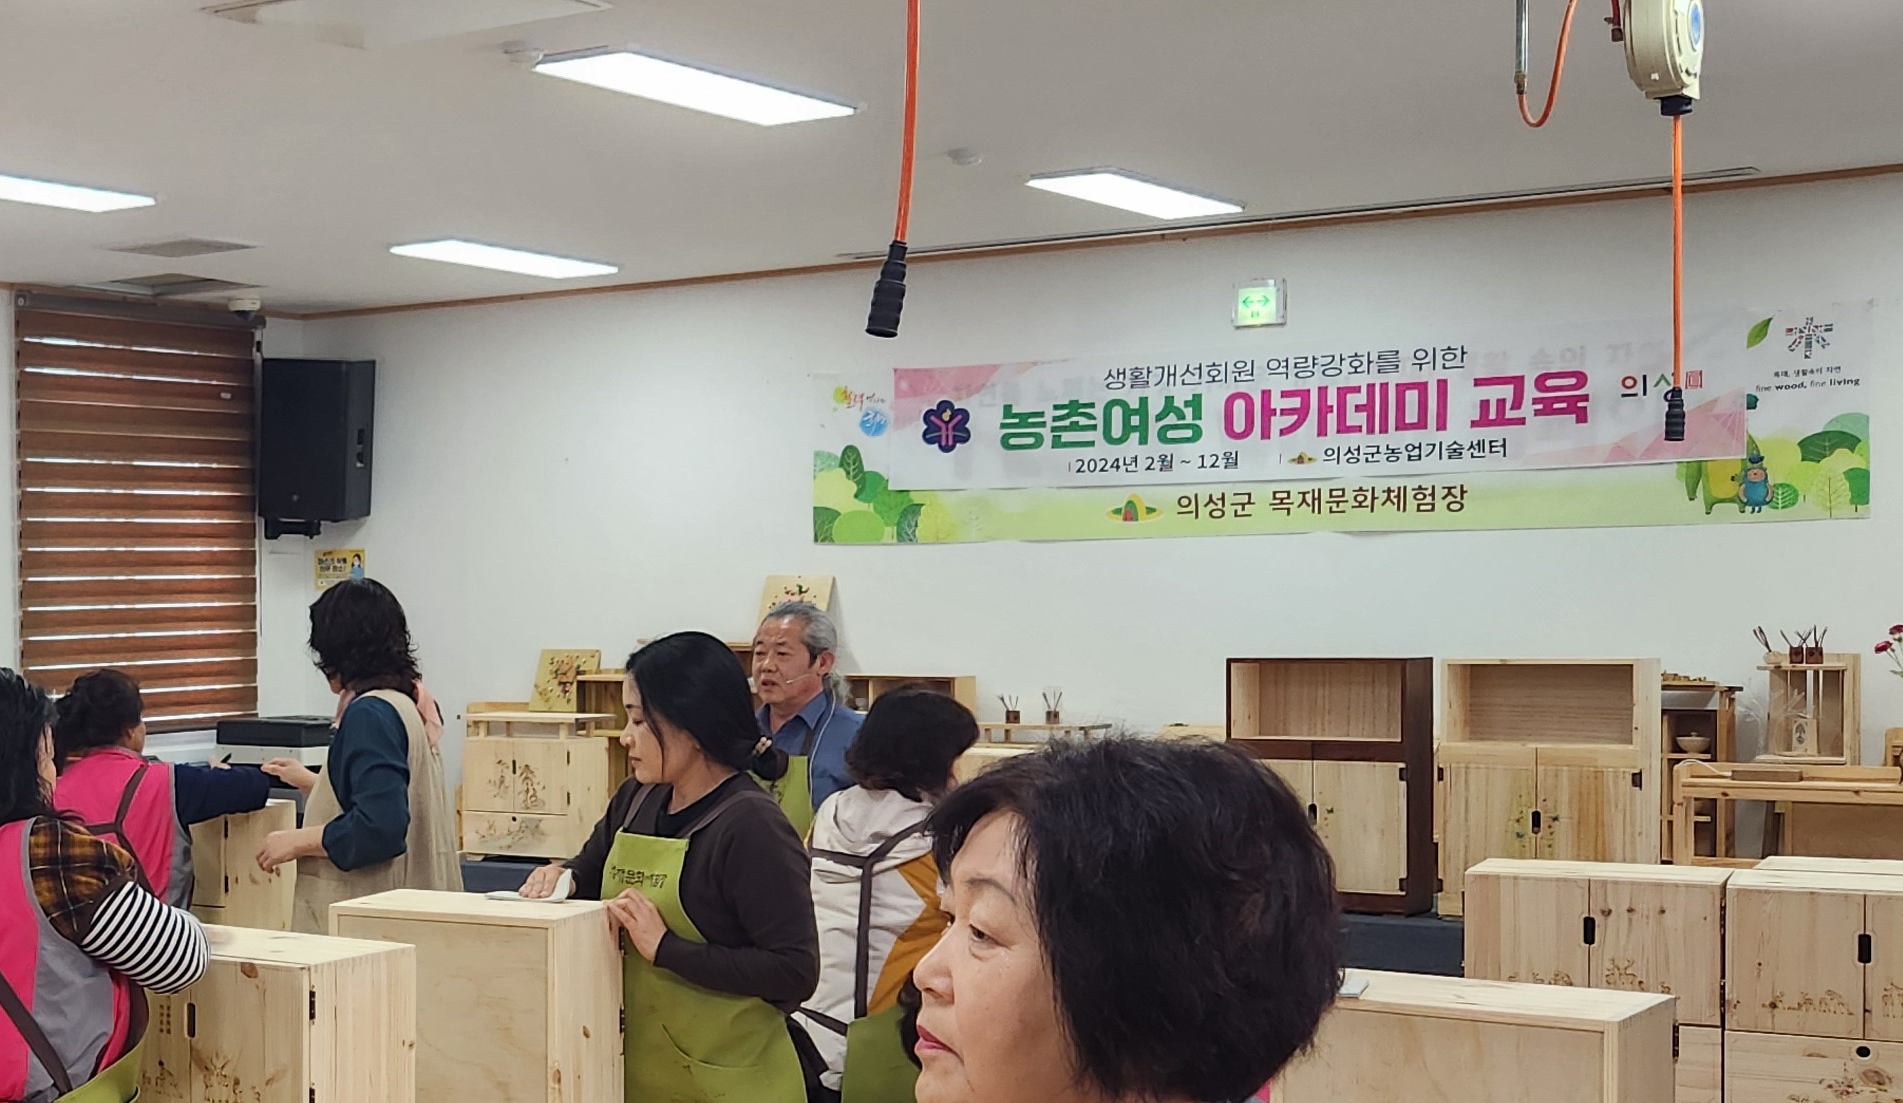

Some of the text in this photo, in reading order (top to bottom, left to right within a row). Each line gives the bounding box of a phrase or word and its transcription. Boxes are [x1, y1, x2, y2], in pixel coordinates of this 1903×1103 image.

[1103, 360, 1256, 391] 생활개선회원
[1266, 350, 1401, 380] 역량강화를
[1411, 345, 1468, 373] 위한
[1829, 378, 1860, 386] living
[998, 370, 1591, 452] 농촌여성 아카데미 교육
[1075, 455, 1139, 474] 2024년
[1144, 453, 1174, 472] 2월
[1197, 451, 1239, 470] 12월
[1322, 438, 1507, 466] 의성군농업기술센터
[1176, 483, 1469, 520] 의성군 목재문화체험장
